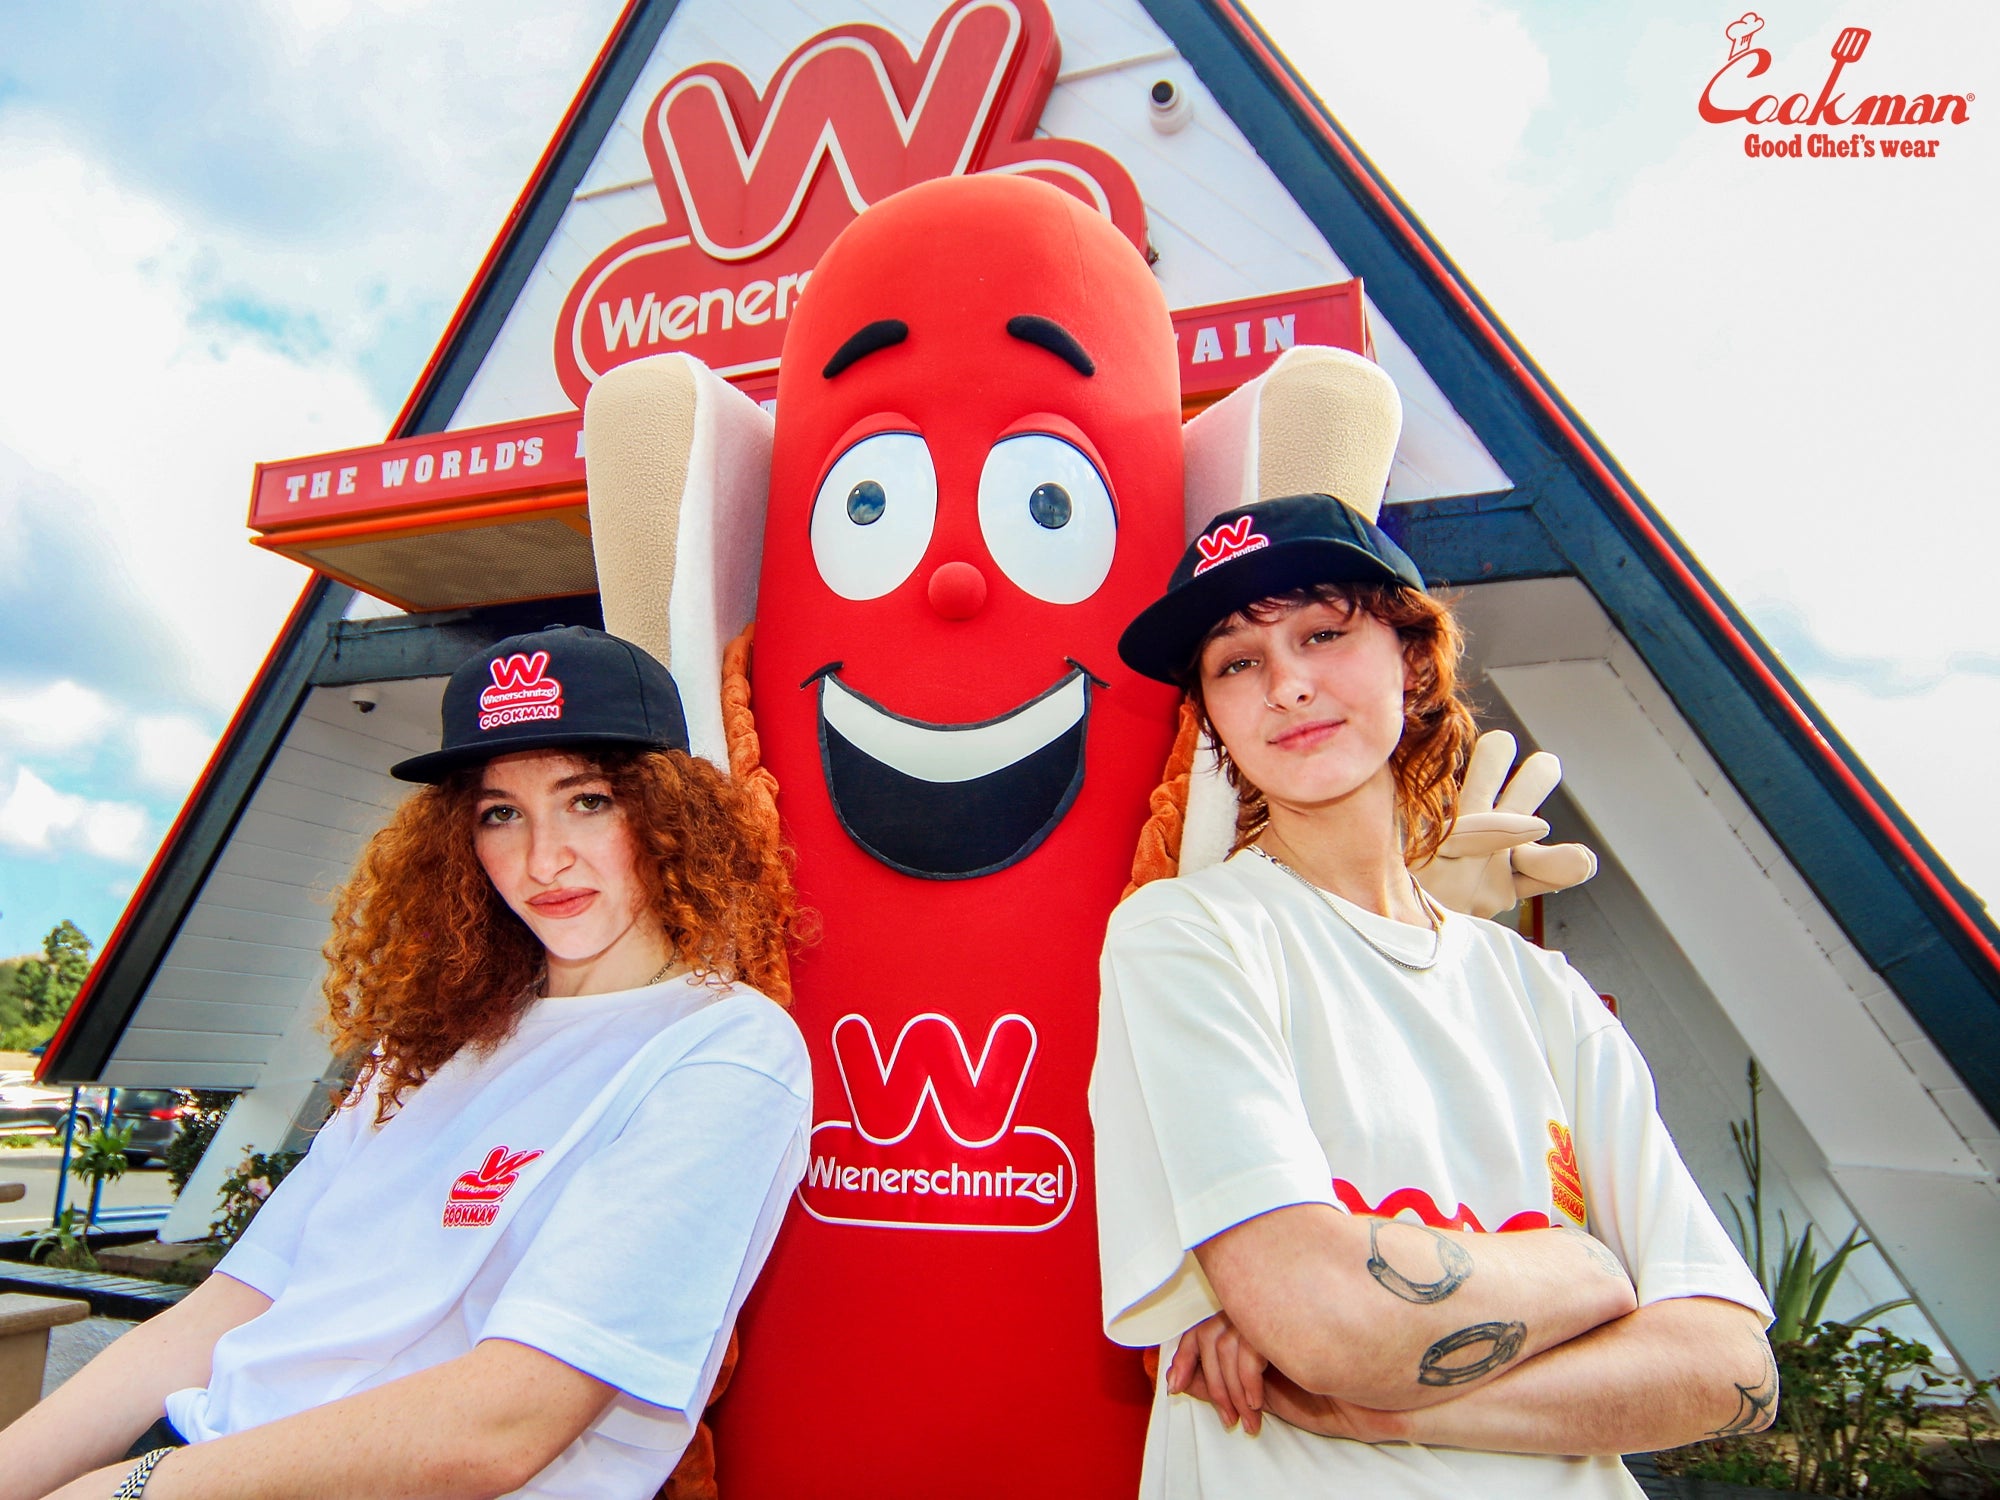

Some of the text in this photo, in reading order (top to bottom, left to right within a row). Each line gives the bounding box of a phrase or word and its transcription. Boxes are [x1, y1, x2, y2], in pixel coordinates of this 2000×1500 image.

[1175, 313, 1296, 365] AIN
[286, 467, 358, 502] THE
[381, 436, 544, 488] WORLD'S
[490, 651, 548, 690] W
[480, 705, 560, 730] COOKMAN
[483, 686, 556, 705] Wienerschnitzel
[832, 1013, 1038, 1148] W
[808, 1155, 1064, 1204] Wienerschnitzel
[443, 1204, 499, 1228] COOKMAN
